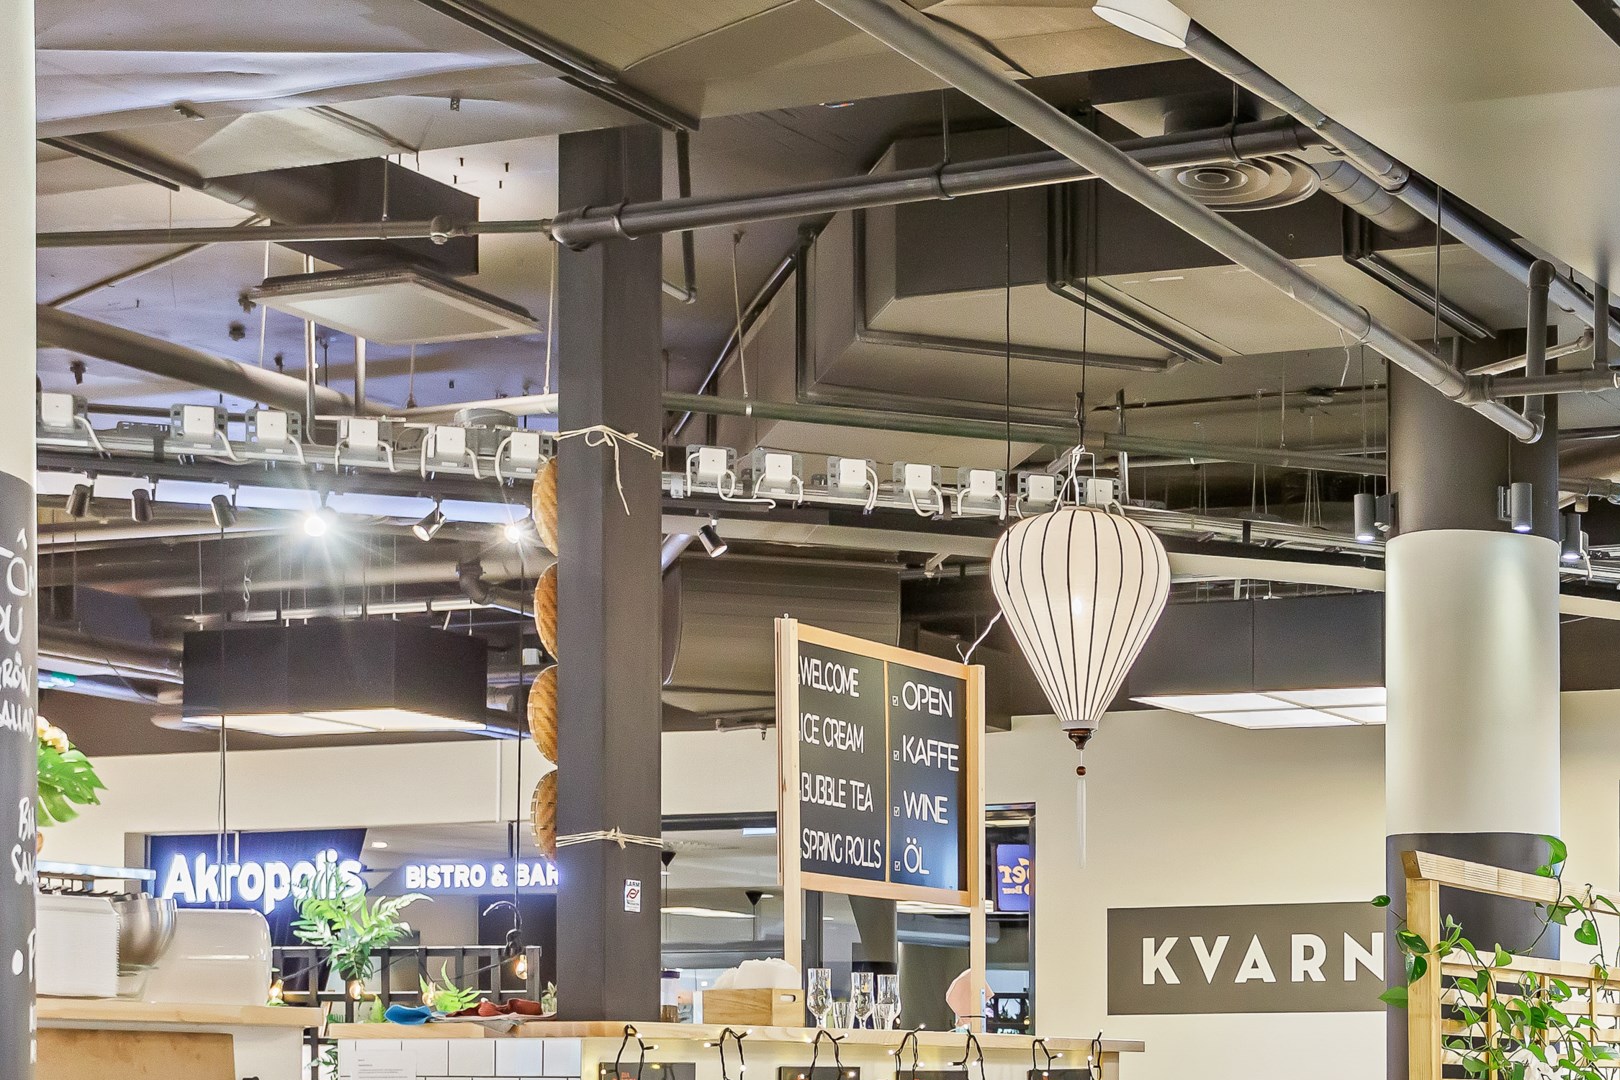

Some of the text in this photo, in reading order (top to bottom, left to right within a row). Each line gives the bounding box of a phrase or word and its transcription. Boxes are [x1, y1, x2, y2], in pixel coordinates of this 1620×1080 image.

[799, 655, 860, 698] WELCOME
[902, 681, 953, 718] OPEN
[800, 712, 864, 754] ICE CREAM
[902, 734, 960, 772] KAFFE
[801, 772, 874, 812] BUBBLE TEA
[903, 790, 949, 825] WINE
[802, 827, 882, 869] SPRING ROLLS
[903, 836, 930, 875] ÖL
[161, 848, 366, 915] Akropolis
[405, 863, 486, 889] BISTRO
[491, 863, 509, 888] &
[1142, 931, 1385, 985] KVARN
